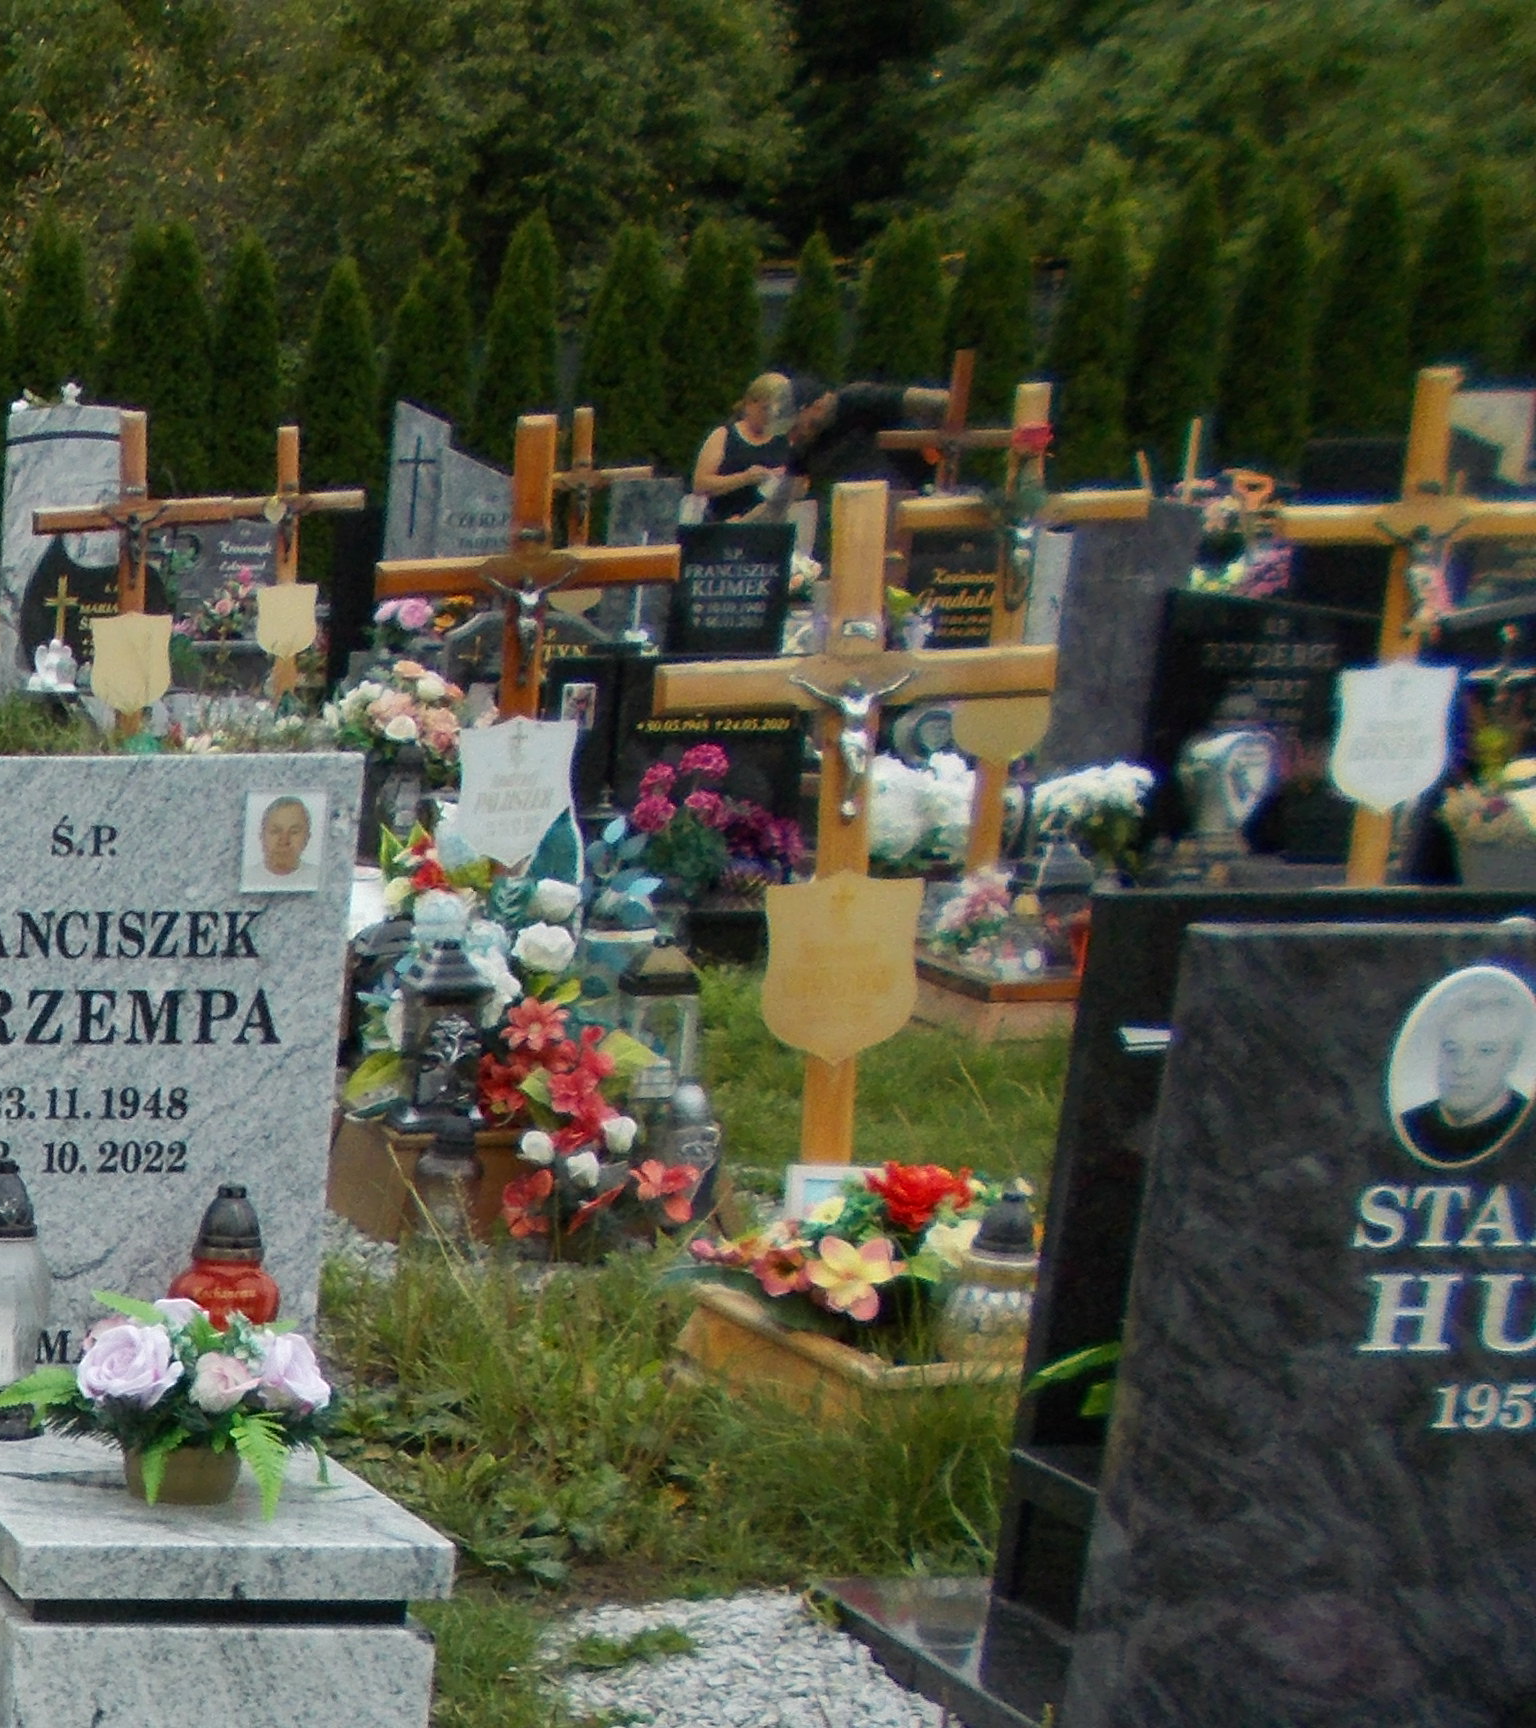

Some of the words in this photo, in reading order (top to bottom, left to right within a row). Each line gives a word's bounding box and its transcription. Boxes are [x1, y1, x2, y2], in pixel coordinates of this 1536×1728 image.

[685, 563, 780, 578] FRANCISZEK
[692, 579, 771, 597] KLIMEK
[50, 815, 119, 858] Ś.P.
[1353, 1184, 1536, 1249] STA
[1358, 1273, 1536, 1353] HU
[1430, 1382, 1536, 1430] 195
